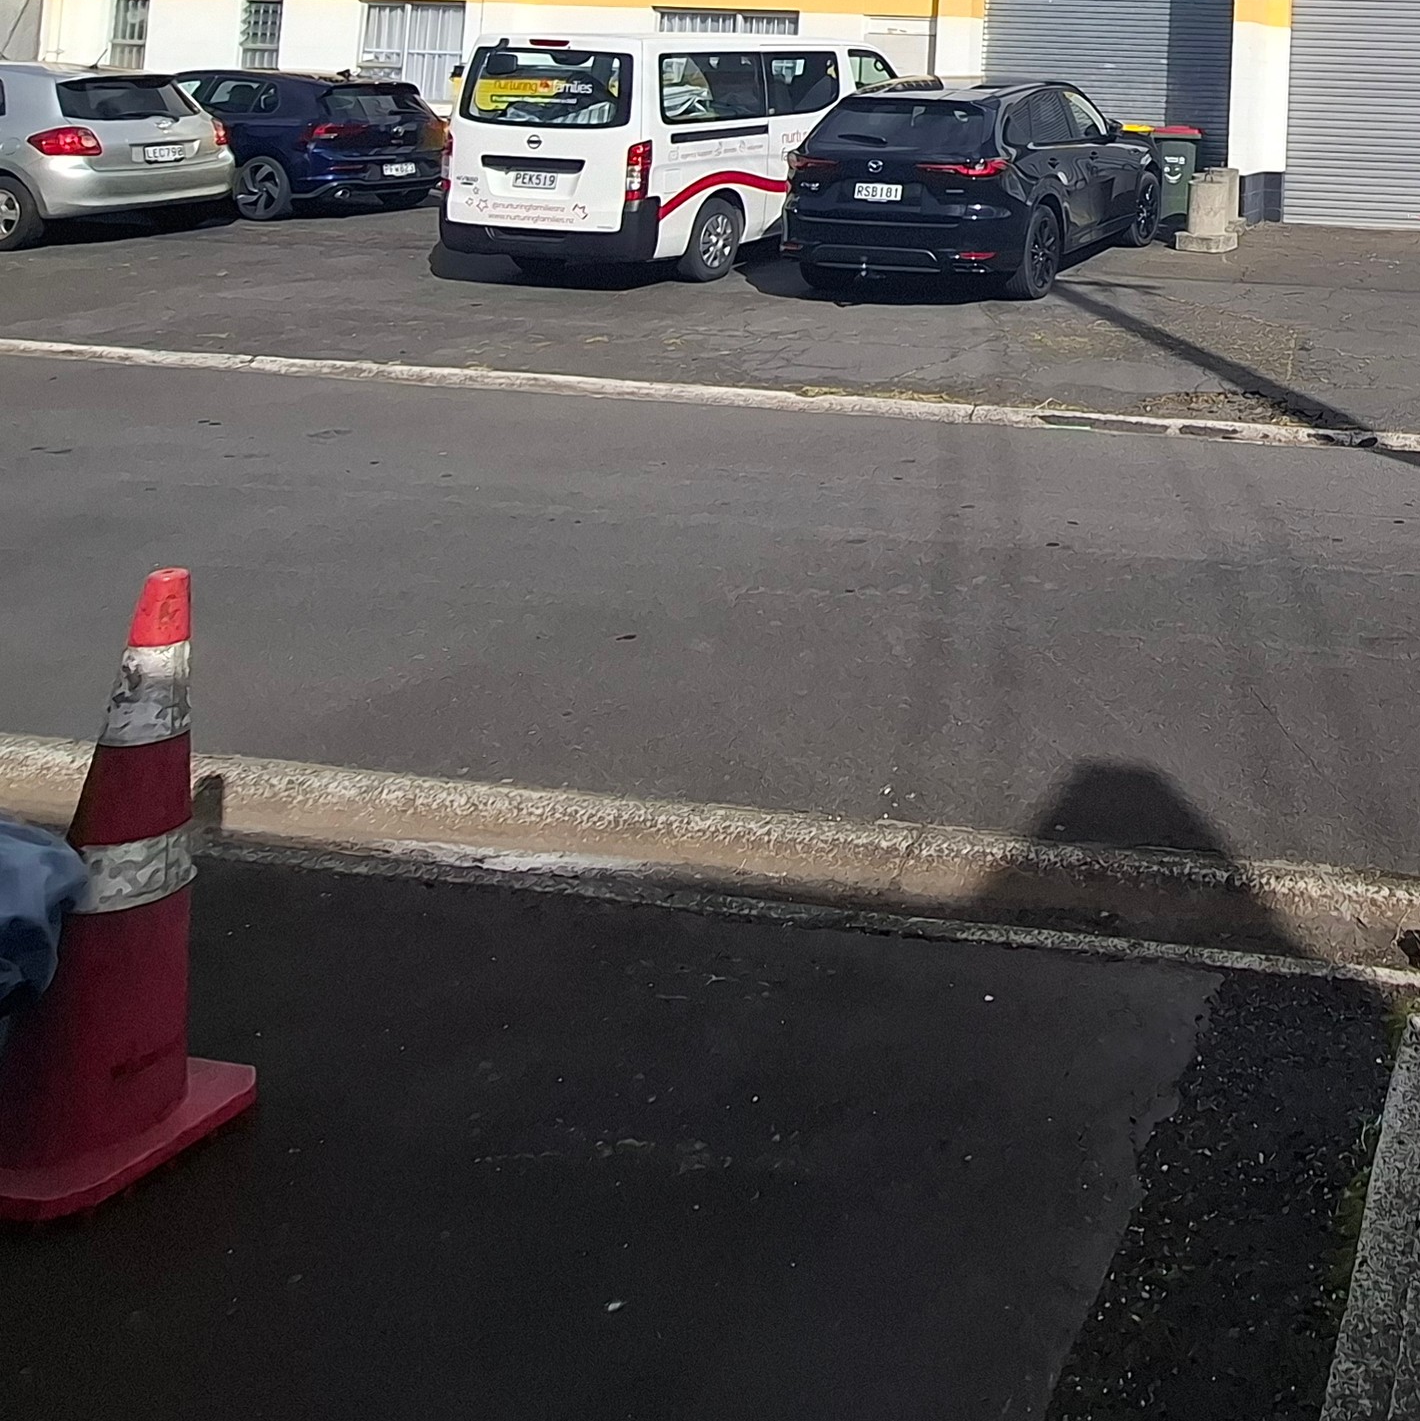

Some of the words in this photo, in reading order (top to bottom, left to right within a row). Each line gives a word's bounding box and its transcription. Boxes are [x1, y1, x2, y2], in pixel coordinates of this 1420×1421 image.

[493, 80, 538, 94] nurturing
[514, 172, 557, 187] PEK519
[856, 185, 899, 199] RSB181
